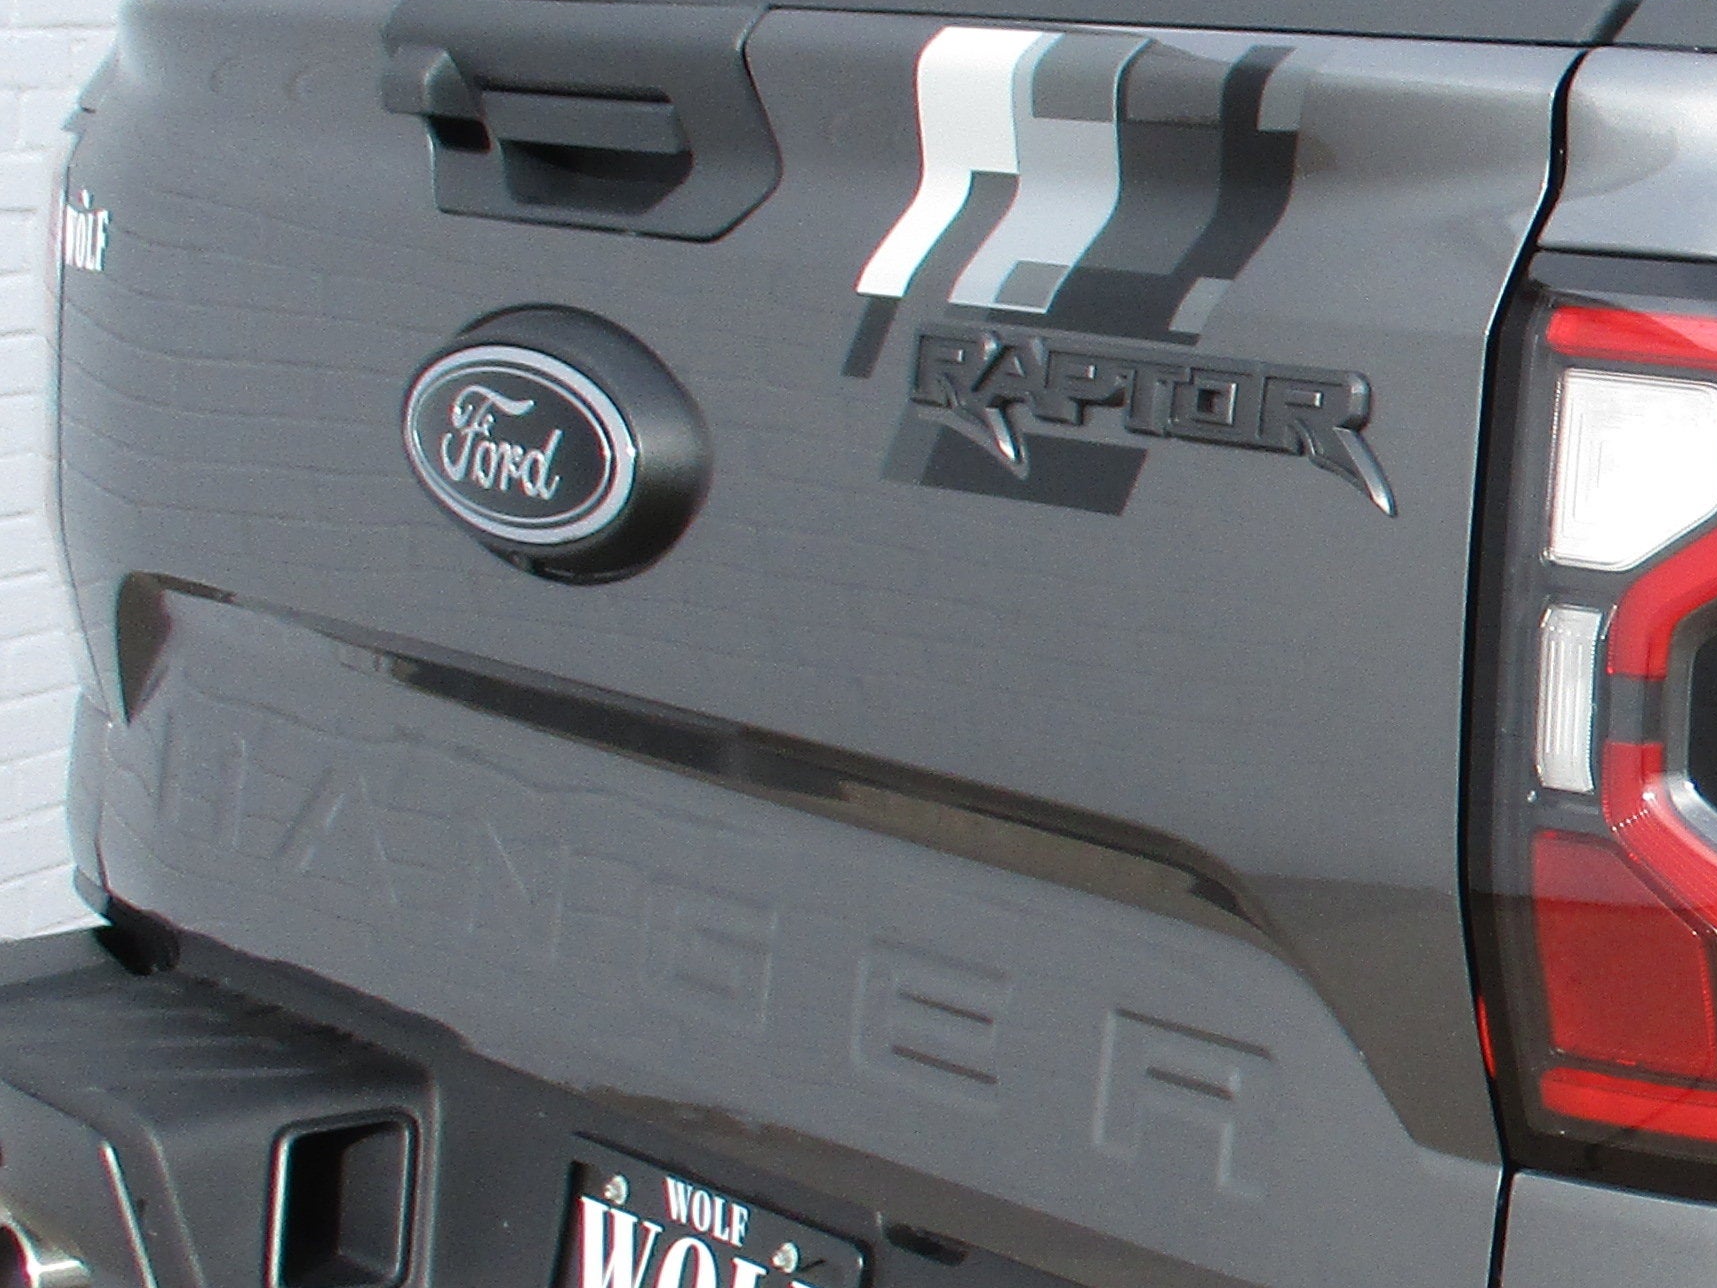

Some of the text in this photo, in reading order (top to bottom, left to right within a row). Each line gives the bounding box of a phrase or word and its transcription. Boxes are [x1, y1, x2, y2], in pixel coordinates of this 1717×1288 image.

[438, 385, 563, 503] Ford
[911, 323, 1400, 518] RAPTOR
[152, 712, 1276, 1198] RANGER
[664, 1175, 749, 1245] WOLF
